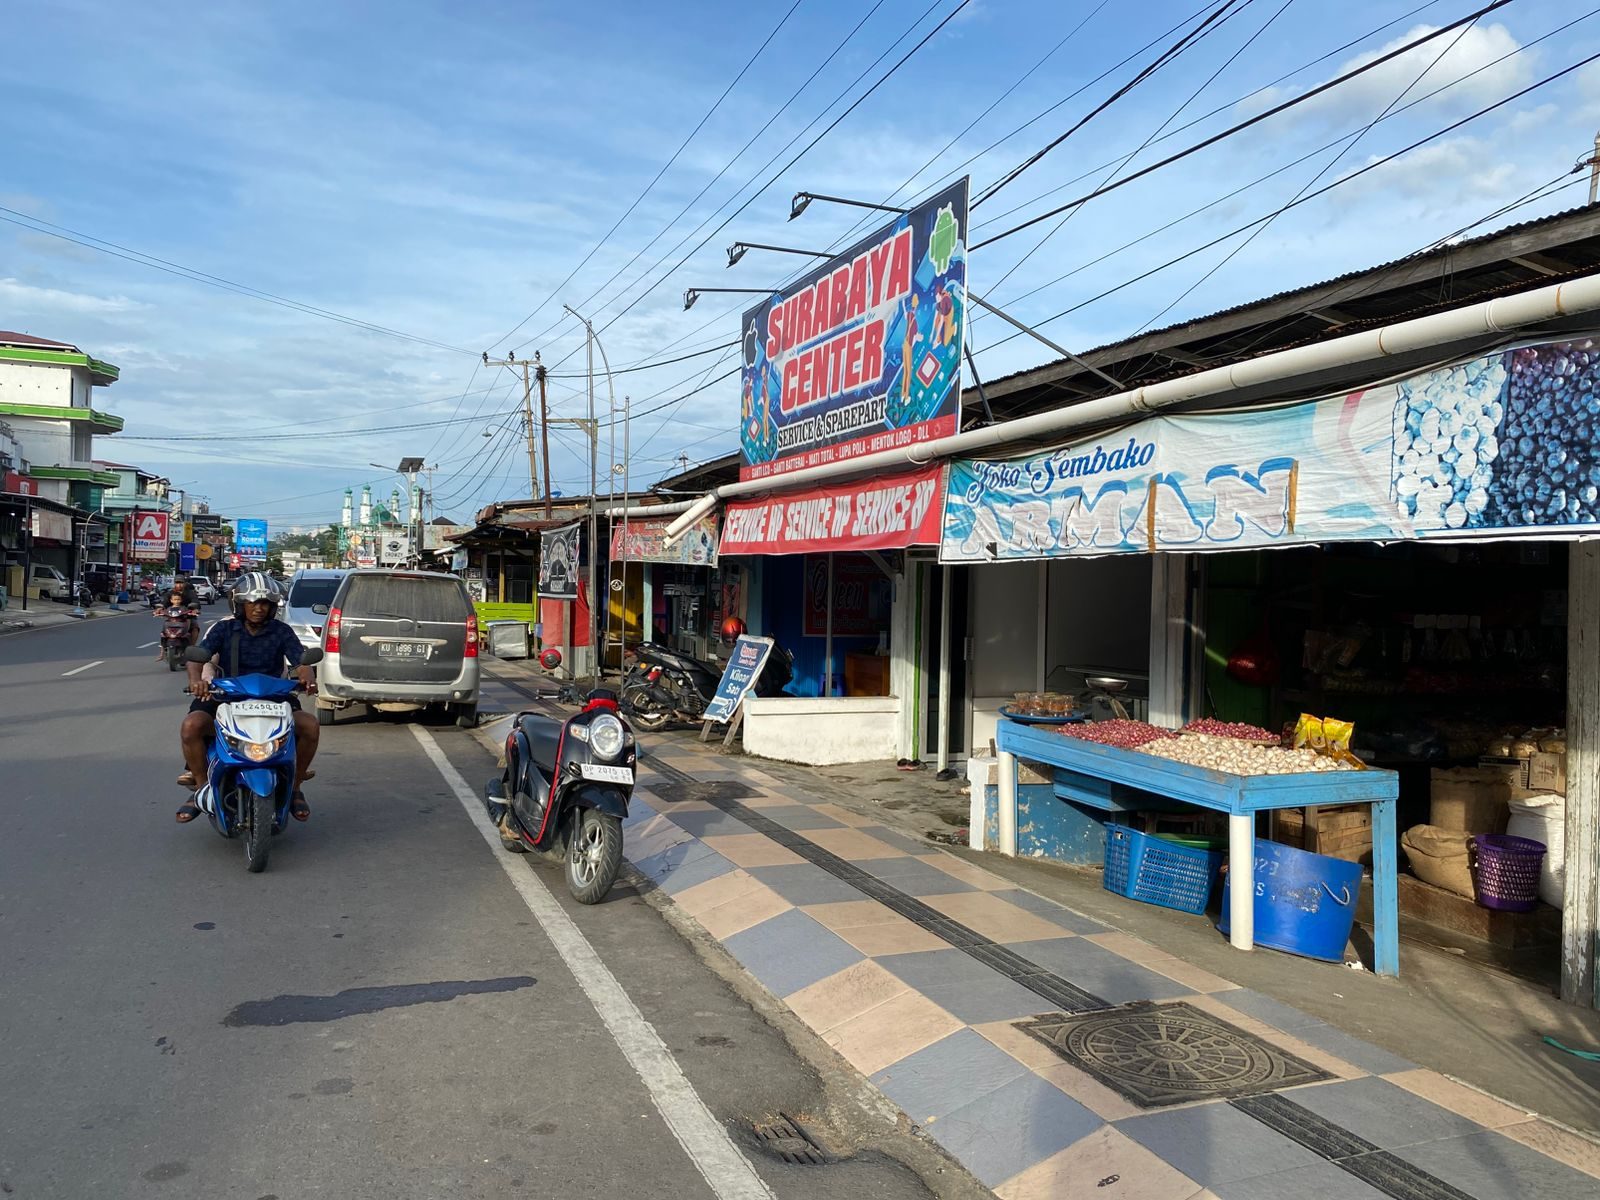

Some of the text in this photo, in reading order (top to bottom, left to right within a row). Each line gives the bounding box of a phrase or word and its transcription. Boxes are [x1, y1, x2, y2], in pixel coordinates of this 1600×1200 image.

[767, 227, 911, 359] SURABAYA
[782, 320, 885, 412] CENTER
[752, 466, 763, 478] GANTI
[773, 461, 785, 474] GANTI
[785, 456, 805, 471] BATTERAI
[808, 452, 820, 465] MATI
[821, 449, 834, 462] TOTAL
[839, 444, 852, 458] LUPA
[852, 440, 866, 455] POLA
[871, 433, 895, 451] MENTOK
[896, 429, 912, 445] LOGO
[917, 424, 929, 440] DLL
[778, 403, 887, 449] SERVICE & SPAREPART
[1026, 438, 1155, 495] Sembako
[725, 478, 935, 543] SERVICE HP SERVICE HP SERVICE HP
[961, 457, 1299, 554] ARMAN
